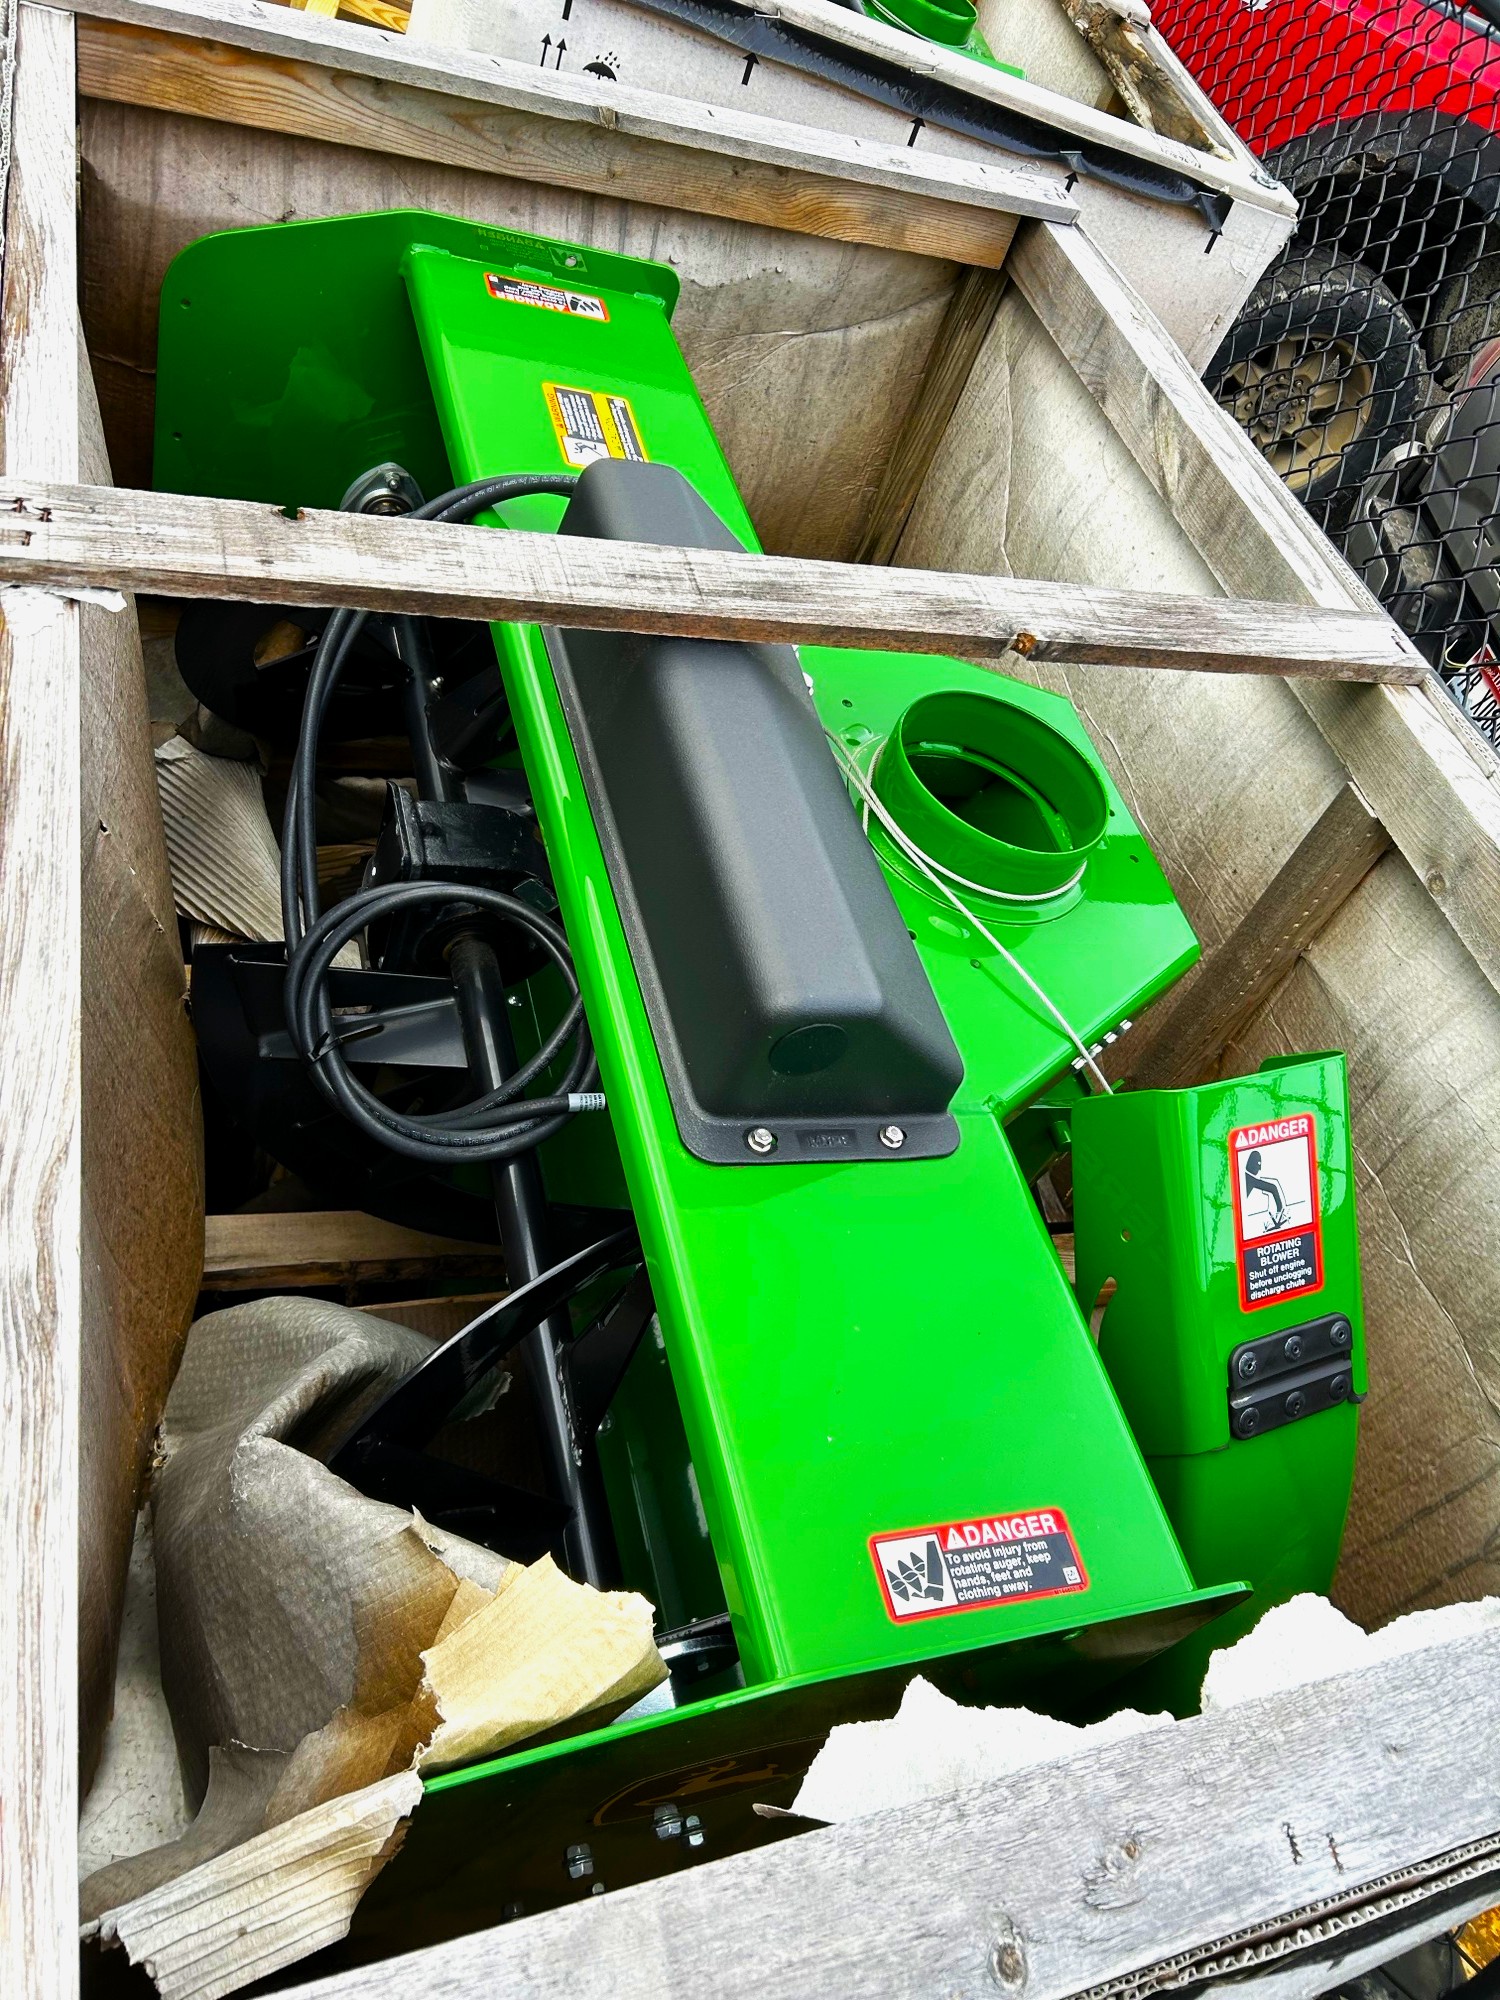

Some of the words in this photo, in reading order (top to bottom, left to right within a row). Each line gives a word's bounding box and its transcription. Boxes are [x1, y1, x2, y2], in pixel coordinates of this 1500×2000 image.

[547, 393, 562, 424] WARNING
[1248, 1118, 1309, 1146] DANGER
[1256, 1238, 1302, 1258] ROTATING
[1260, 1248, 1300, 1267] BLOWER
[1249, 1268, 1267, 1281] Shut
[1268, 1264, 1279, 1276] off
[1280, 1259, 1306, 1274] engine
[1249, 1278, 1273, 1291] before
[1273, 1266, 1313, 1286] unclogging
[1250, 1283, 1285, 1301] discharge
[1285, 1278, 1306, 1291] chute
[963, 1513, 1059, 1544] DANGER
[945, 1553, 961, 1565] To
[961, 1549, 992, 1562] avoid
[993, 1543, 1022, 1560] injury
[1023, 1540, 1048, 1552] from
[950, 1559, 992, 1578] rotating
[993, 1556, 1026, 1573] auger,
[1027, 1551, 1052, 1566] keep
[953, 1572, 991, 1589] hands,
[991, 1569, 1012, 1583] feet
[1013, 1567, 1033, 1579] and
[956, 1584, 1002, 1602] clothing
[1002, 1580, 1033, 1596] away.
